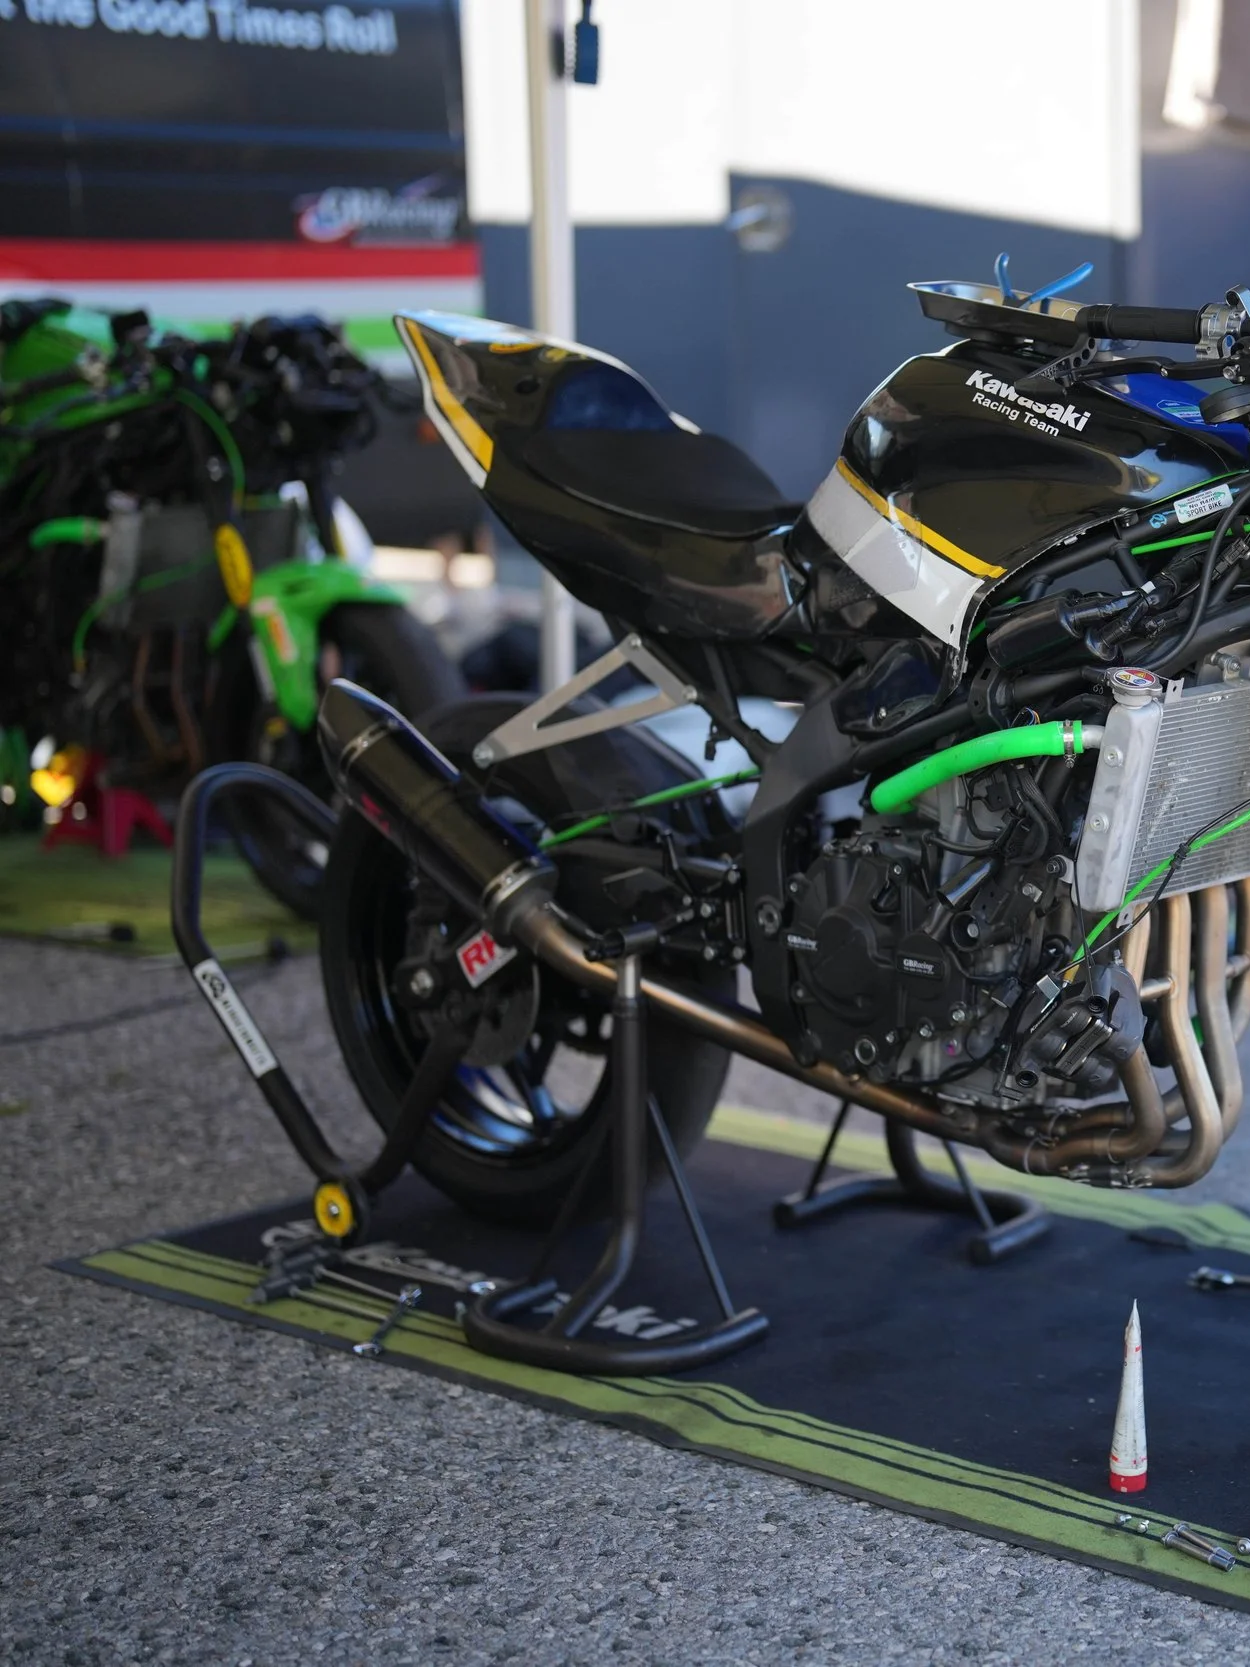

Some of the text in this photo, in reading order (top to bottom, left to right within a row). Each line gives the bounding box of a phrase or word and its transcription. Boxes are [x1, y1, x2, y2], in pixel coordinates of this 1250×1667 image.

[209, 0, 322, 50] Times
[323, 5, 397, 54] Roll
[972, 391, 1060, 437] Racing Team
[1187, 505, 1208, 518] SPORT
[1208, 500, 1223, 511] BIKE
[903, 958, 934, 972] GBRacing
